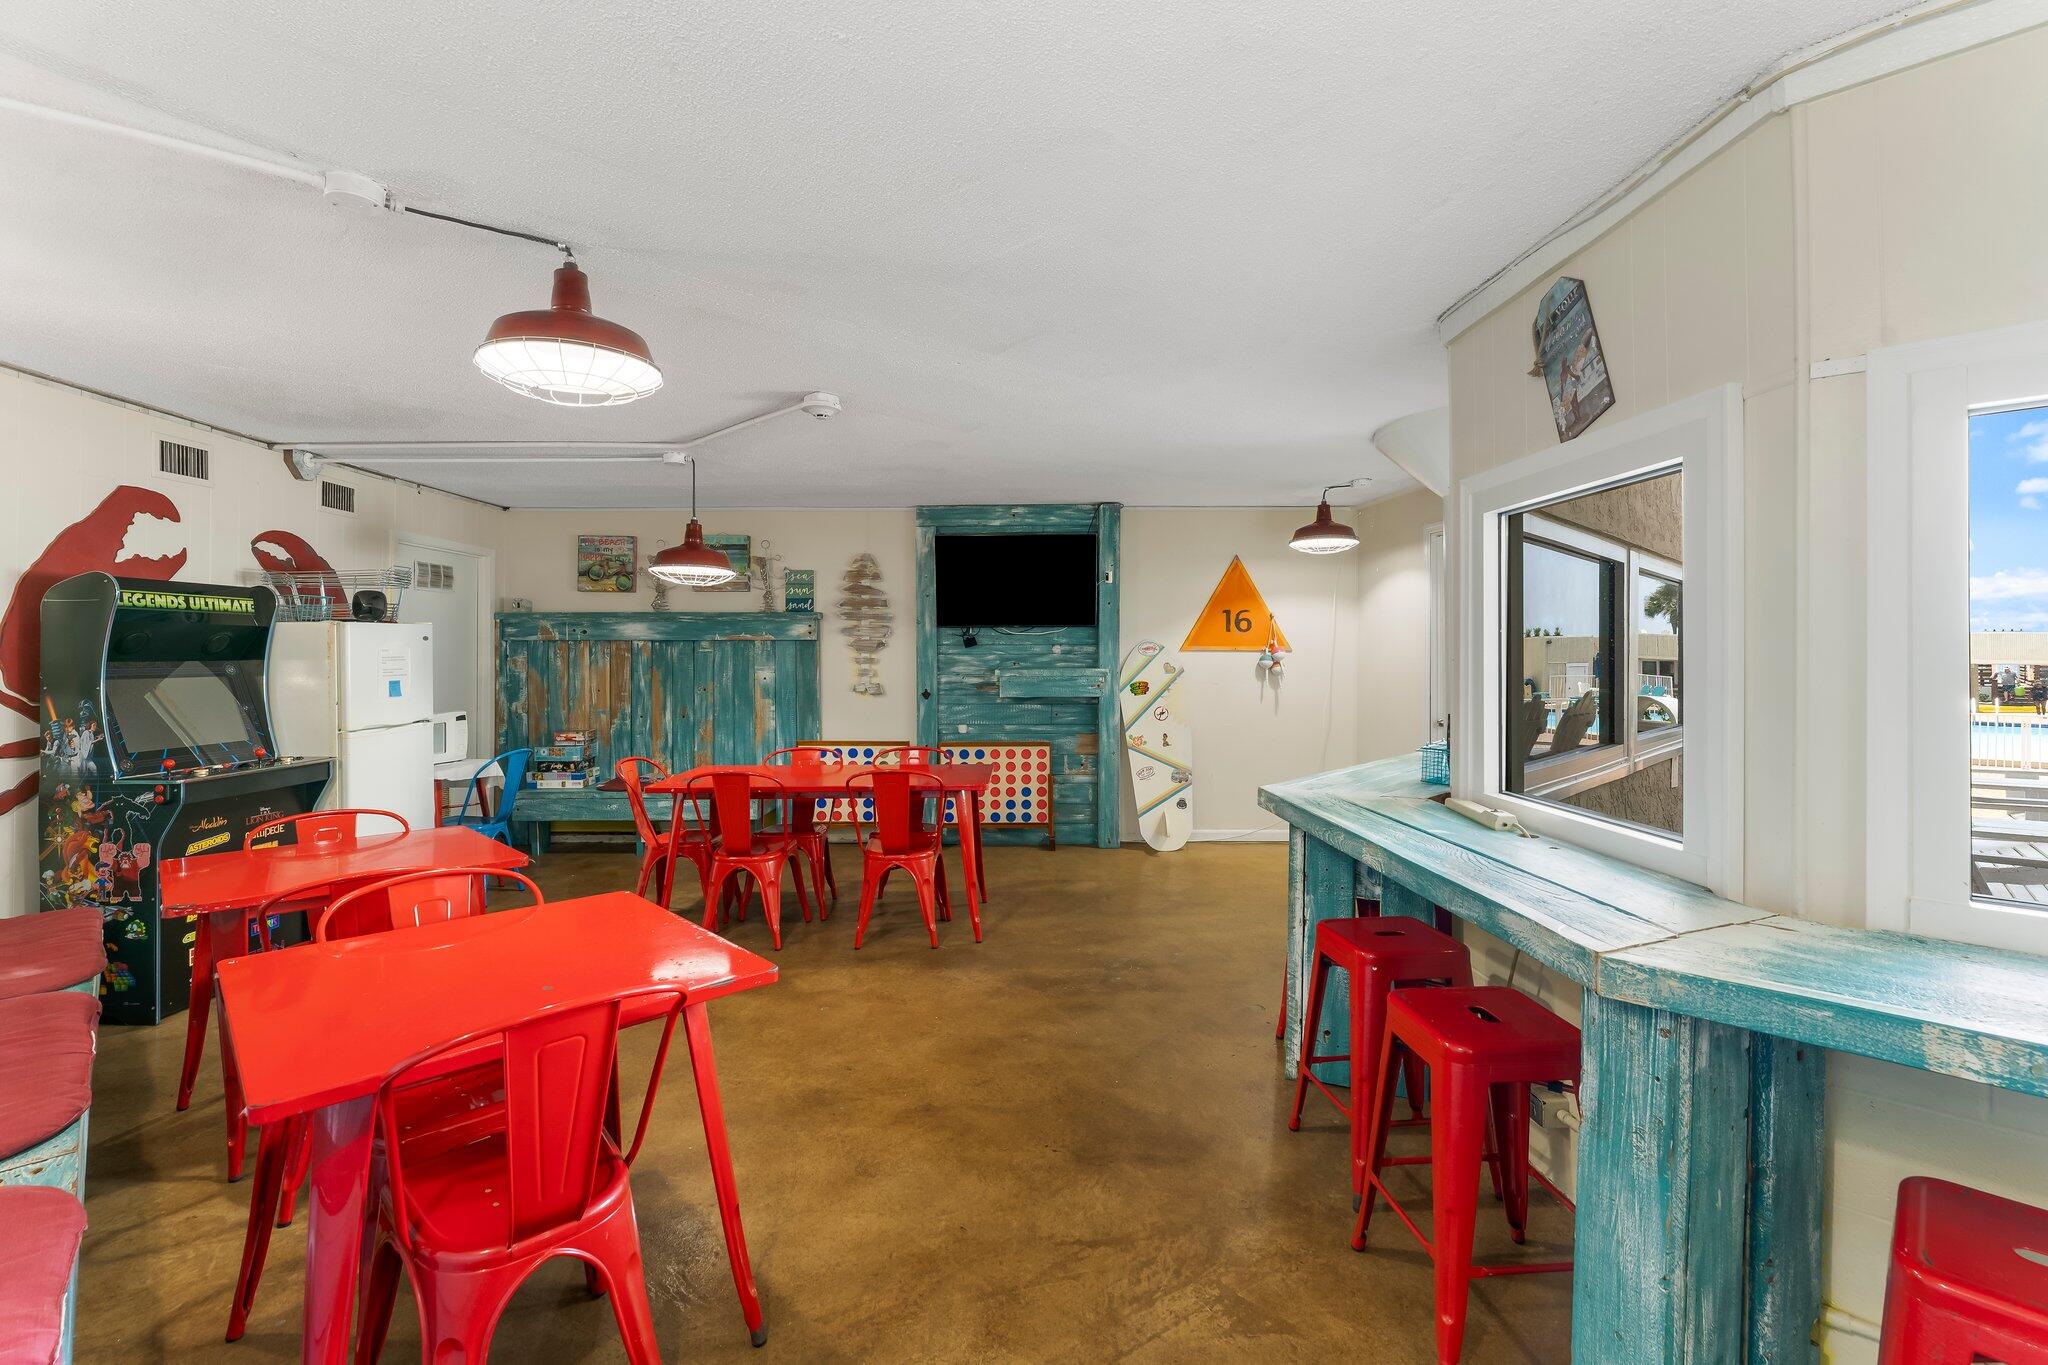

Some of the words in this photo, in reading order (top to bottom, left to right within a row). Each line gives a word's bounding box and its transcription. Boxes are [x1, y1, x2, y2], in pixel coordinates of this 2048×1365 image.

[599, 538, 626, 546] BEACH
[787, 570, 813, 581] sea
[786, 586, 813, 596] sun
[189, 596, 255, 613] ULTIMATE
[787, 598, 814, 611] sand
[1222, 609, 1253, 633] 16
[187, 833, 230, 853] ASTEROIDS
